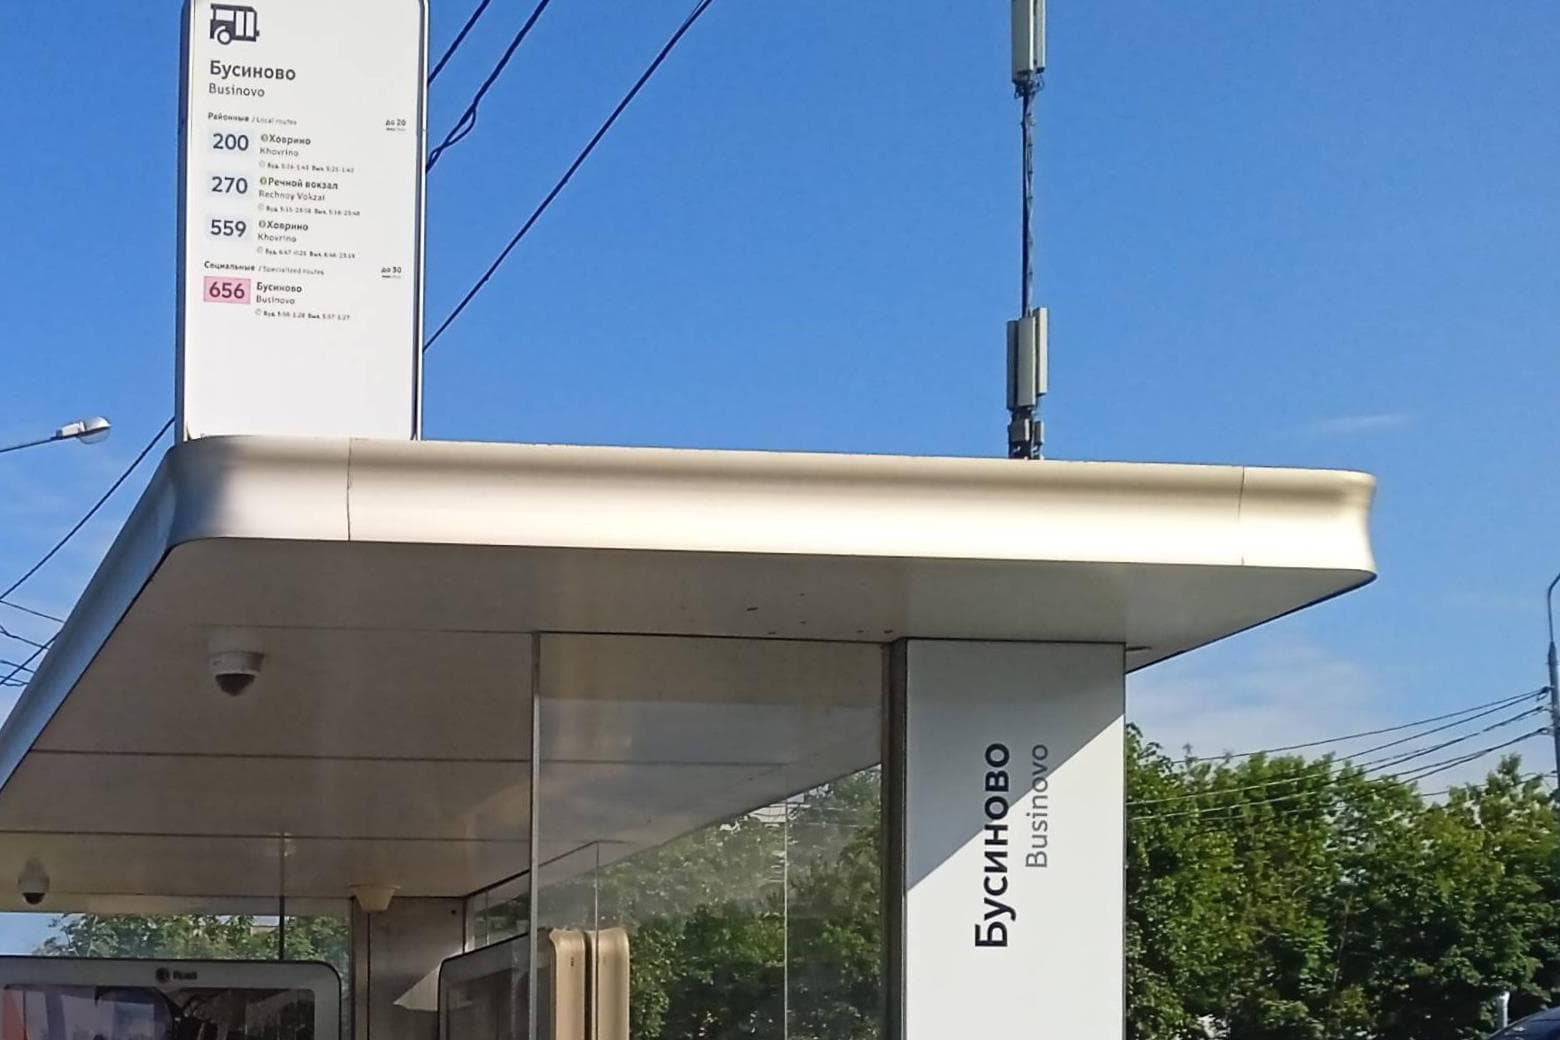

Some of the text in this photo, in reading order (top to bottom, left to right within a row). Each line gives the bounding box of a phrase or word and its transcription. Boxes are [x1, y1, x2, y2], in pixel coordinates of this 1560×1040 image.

[209, 60, 297, 81] Бусиново
[208, 83, 266, 97] Businovo
[212, 132, 249, 151] 200
[269, 134, 312, 146] Ховрино
[260, 147, 299, 157] Khovrino
[211, 176, 248, 194] 270
[268, 176, 339, 190] Речной вокзал
[258, 190, 326, 201] Rechnoy Vokzal
[210, 219, 247, 237] 559
[267, 221, 309, 232] Ховрино
[257, 233, 297, 243] Khovrino
[204, 260, 255, 271] Социальные
[209, 282, 245, 299] 656
[256, 282, 303, 293] Бусиново
[256, 294, 296, 305] Businovo
[1025, 744, 1048, 868] Businovo
[974, 743, 1017, 947] Бусиново
